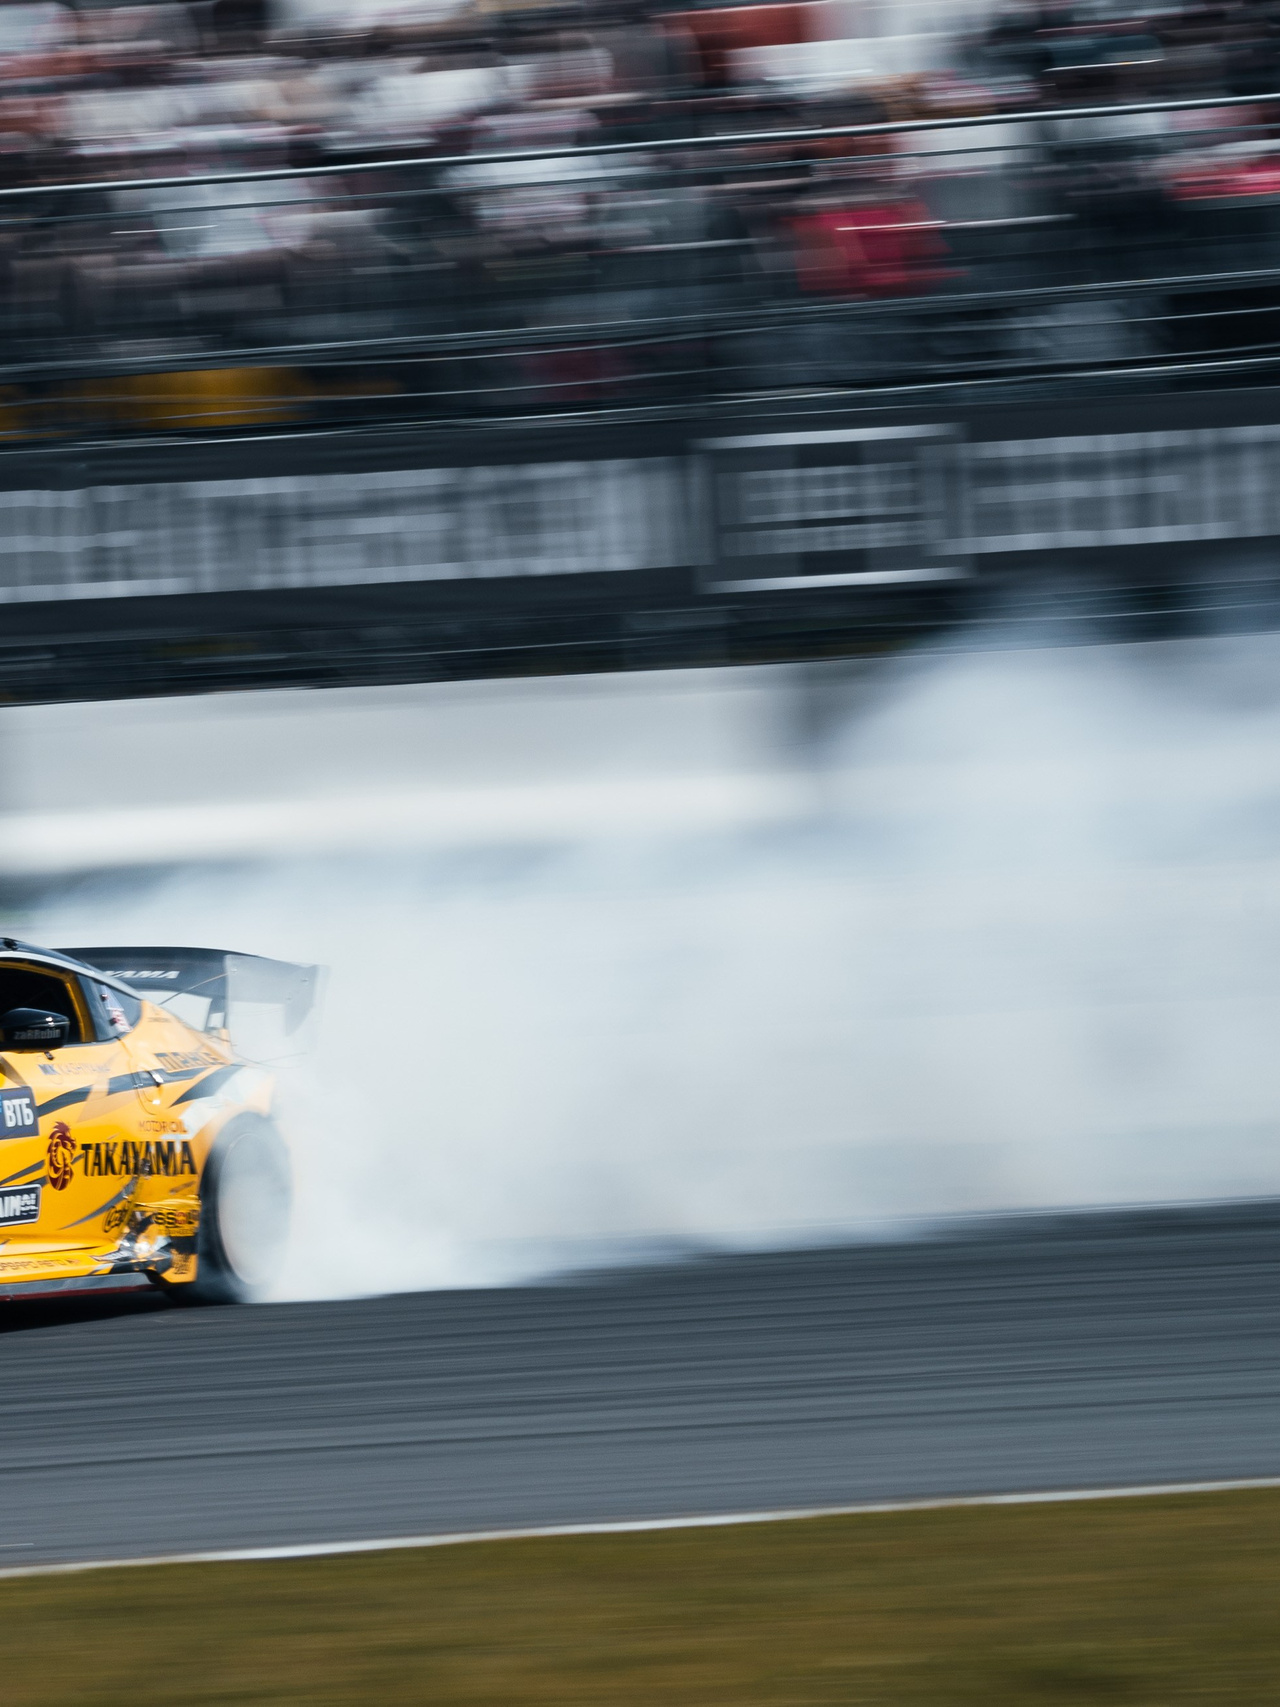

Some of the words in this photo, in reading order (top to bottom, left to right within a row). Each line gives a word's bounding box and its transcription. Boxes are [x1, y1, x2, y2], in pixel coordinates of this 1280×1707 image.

[3, 1098, 34, 1127] ВТБ
[139, 1120, 168, 1133] MOTOR
[169, 1120, 188, 1133] OIL
[81, 1140, 199, 1177] TAKAYAMA
